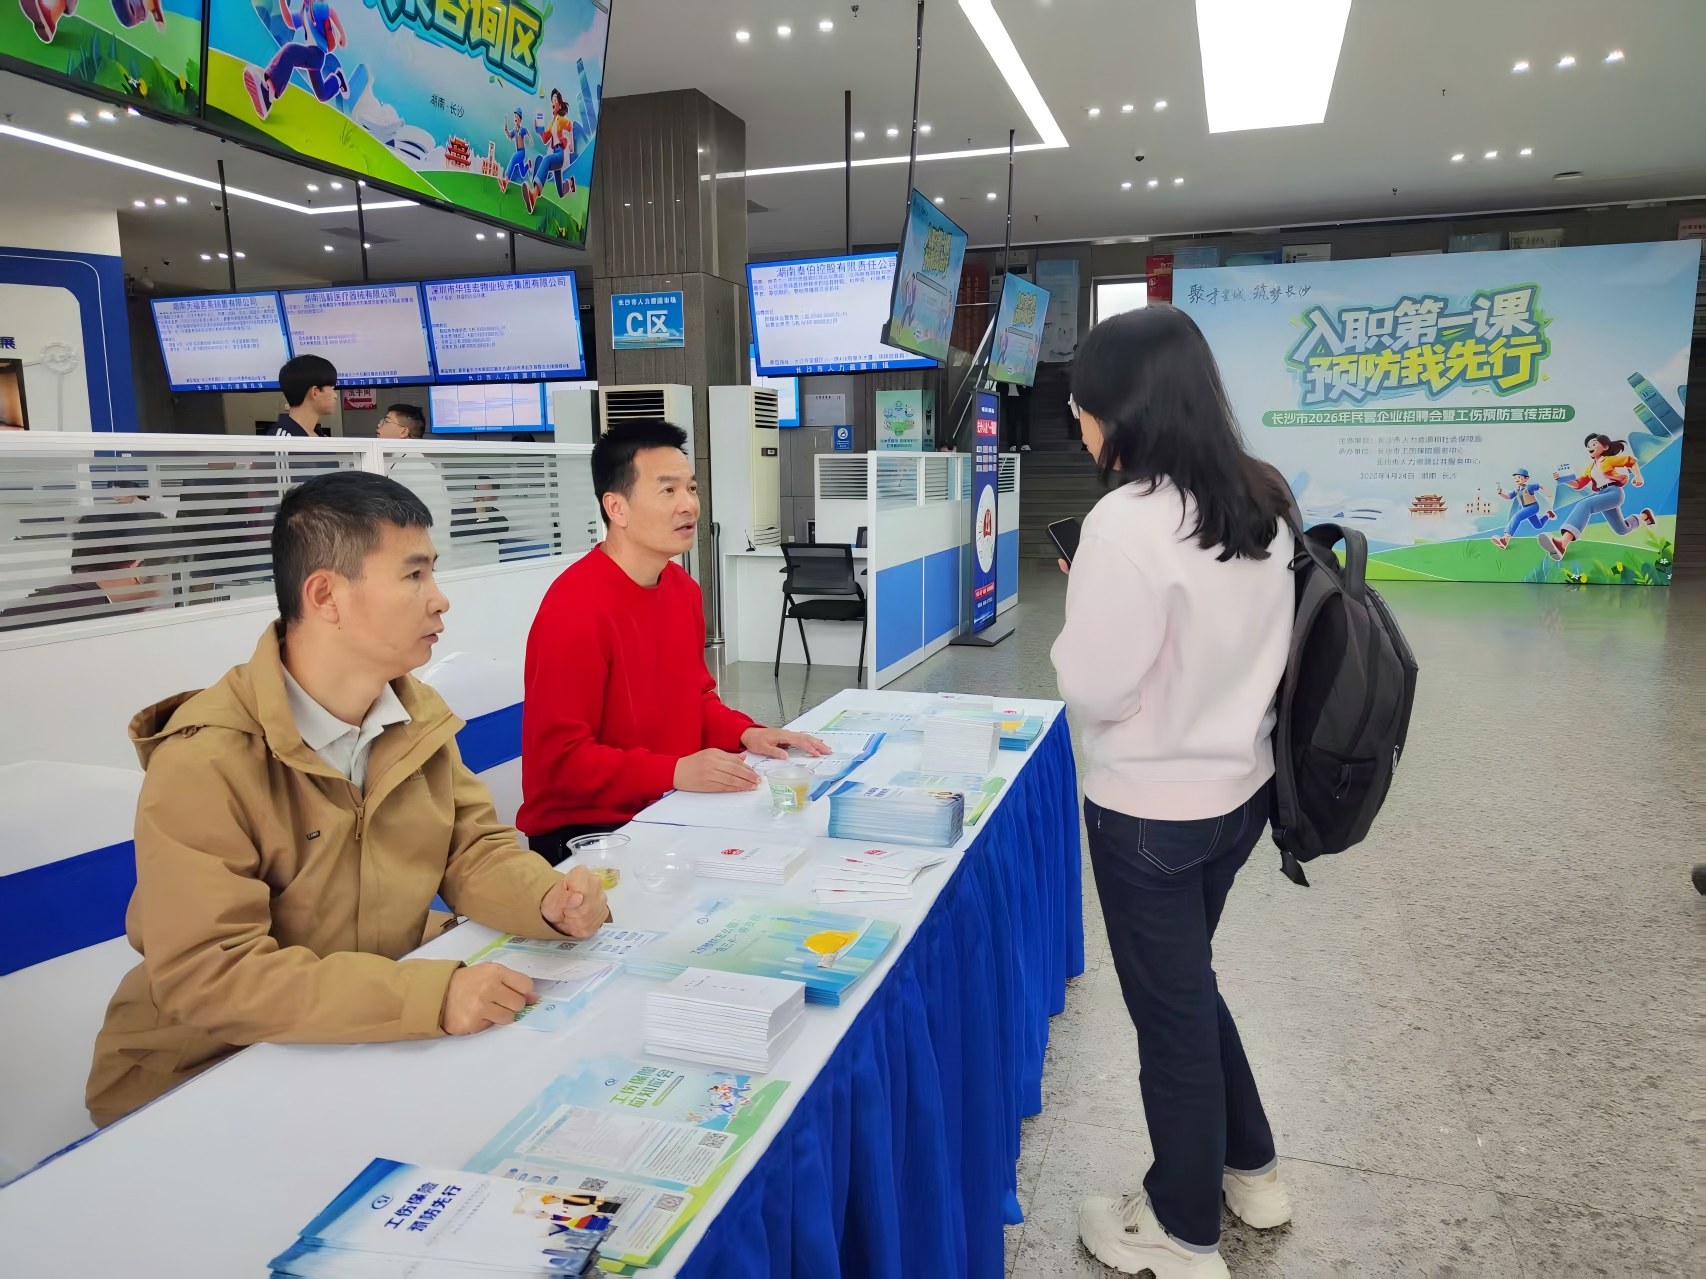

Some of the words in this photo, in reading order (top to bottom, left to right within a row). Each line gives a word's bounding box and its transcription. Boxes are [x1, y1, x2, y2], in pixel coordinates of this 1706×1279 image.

[626, 310, 670, 338] C区
[1293, 289, 1536, 362] 入职第一课
[1305, 335, 1542, 403] 预防我先行
[1271, 407, 1566, 424] 长沙市2026年民营企业招聘会暨工伤预防宣传活动
[384, 1182, 439, 1229] 工伤保险
[407, 1185, 463, 1232] 预防先行
